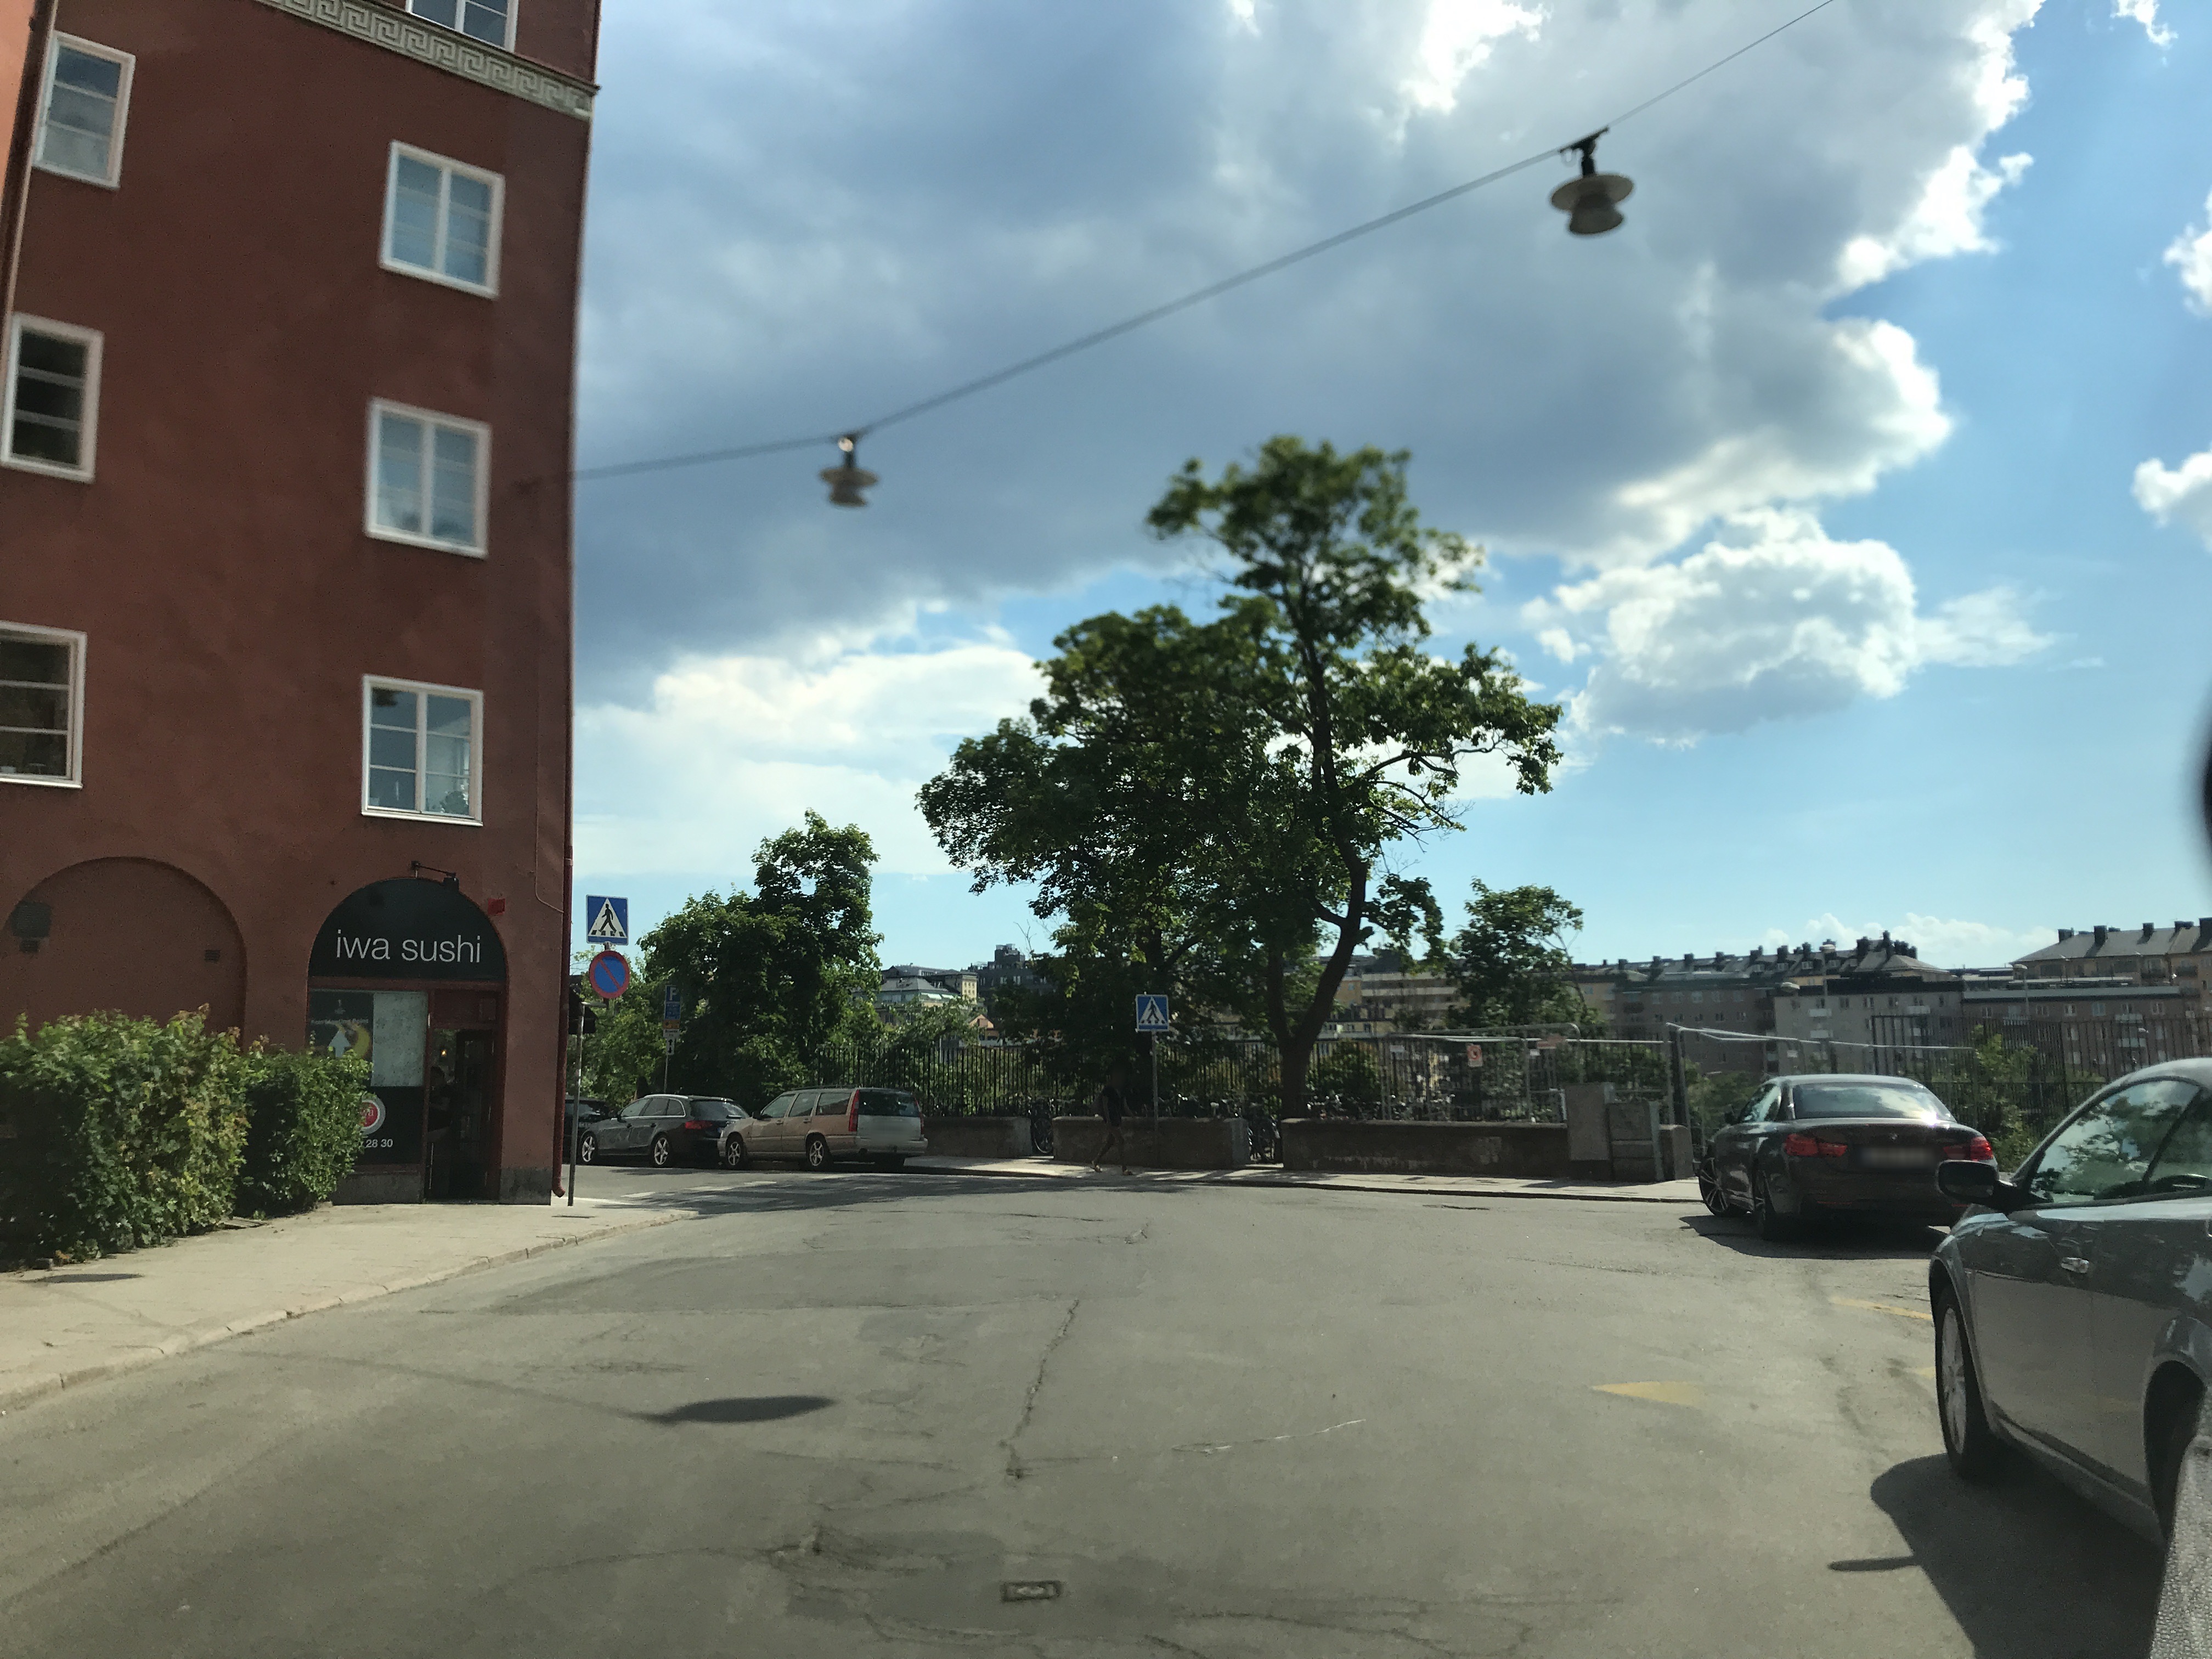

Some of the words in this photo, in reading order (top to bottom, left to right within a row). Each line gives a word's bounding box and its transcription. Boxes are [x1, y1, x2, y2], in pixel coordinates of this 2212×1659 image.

[336, 929, 391, 960] iwa
[401, 935, 481, 963] sushi
[669, 987, 679, 1001] P
[365, 1139, 379, 1148] 28
[380, 1139, 393, 1148] 30
